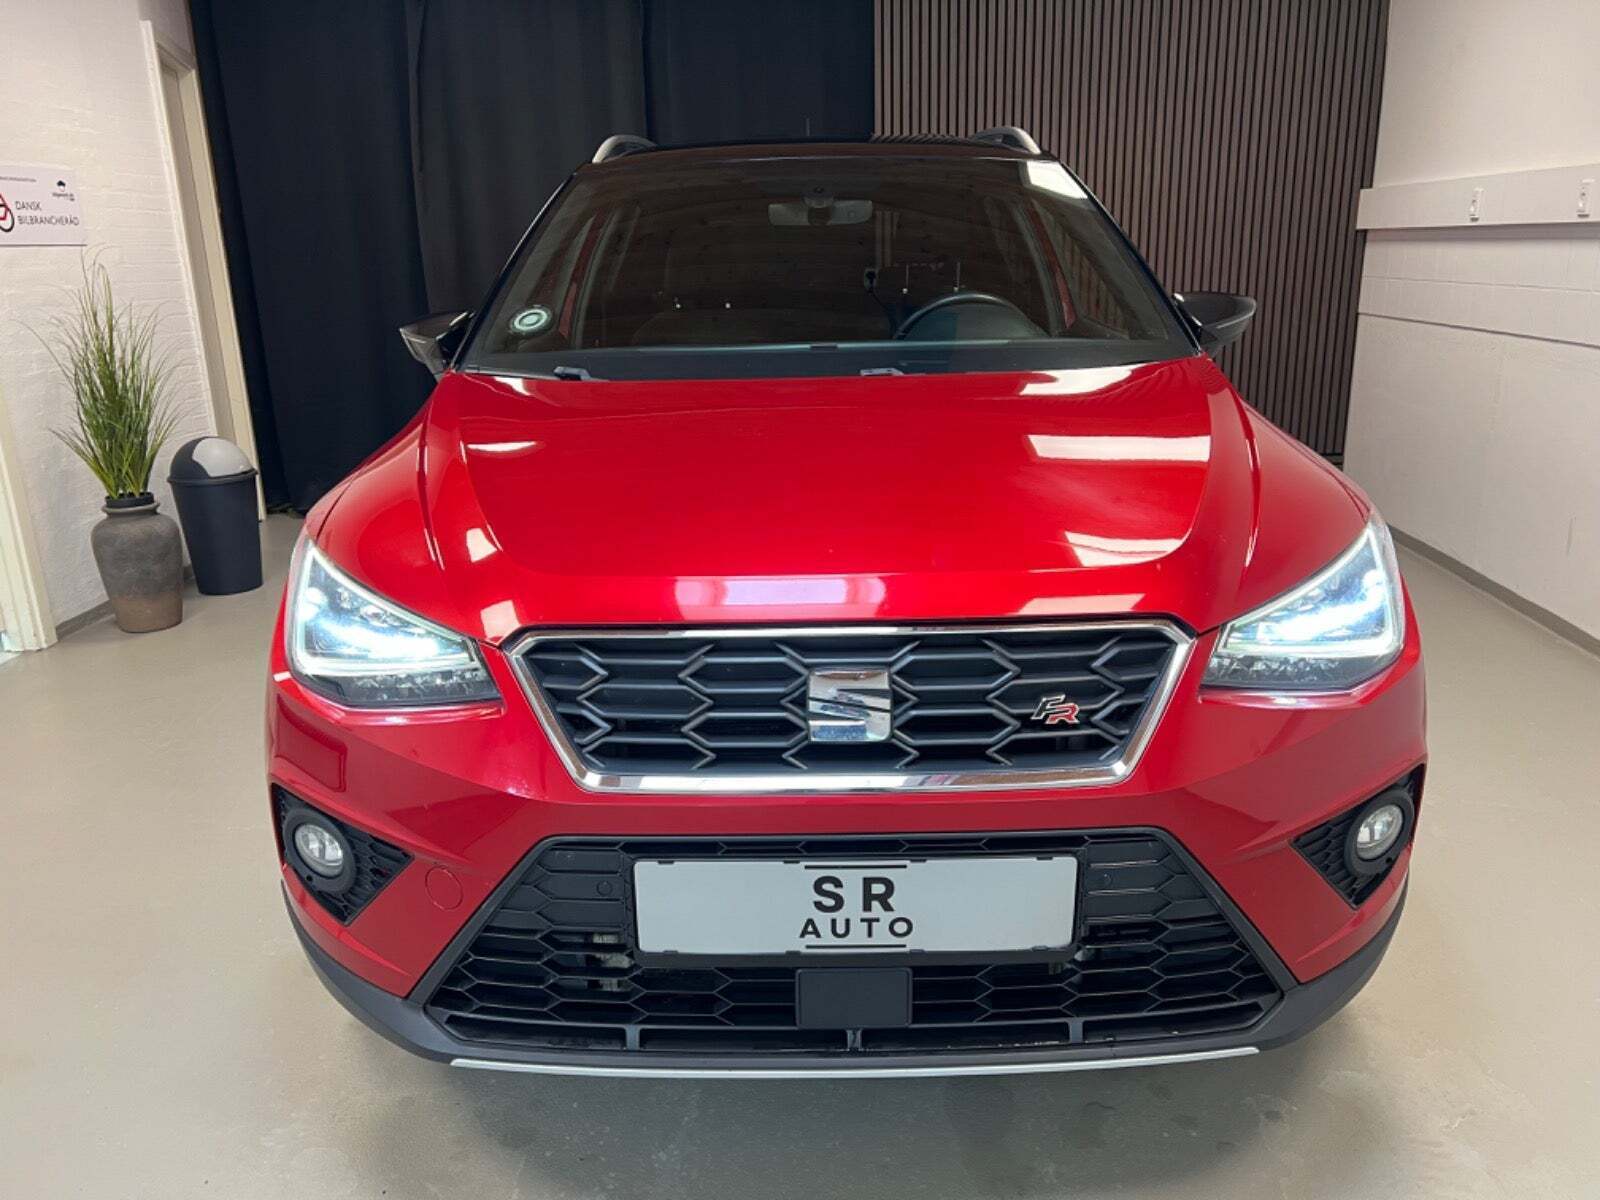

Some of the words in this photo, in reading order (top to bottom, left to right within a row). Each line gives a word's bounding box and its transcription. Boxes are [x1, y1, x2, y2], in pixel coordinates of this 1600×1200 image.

[15, 200, 42, 211] DANSK
[17, 214, 80, 226] BILBRANCHERÅD
[1030, 694, 1080, 725] FR
[799, 916, 914, 939] AUTO
